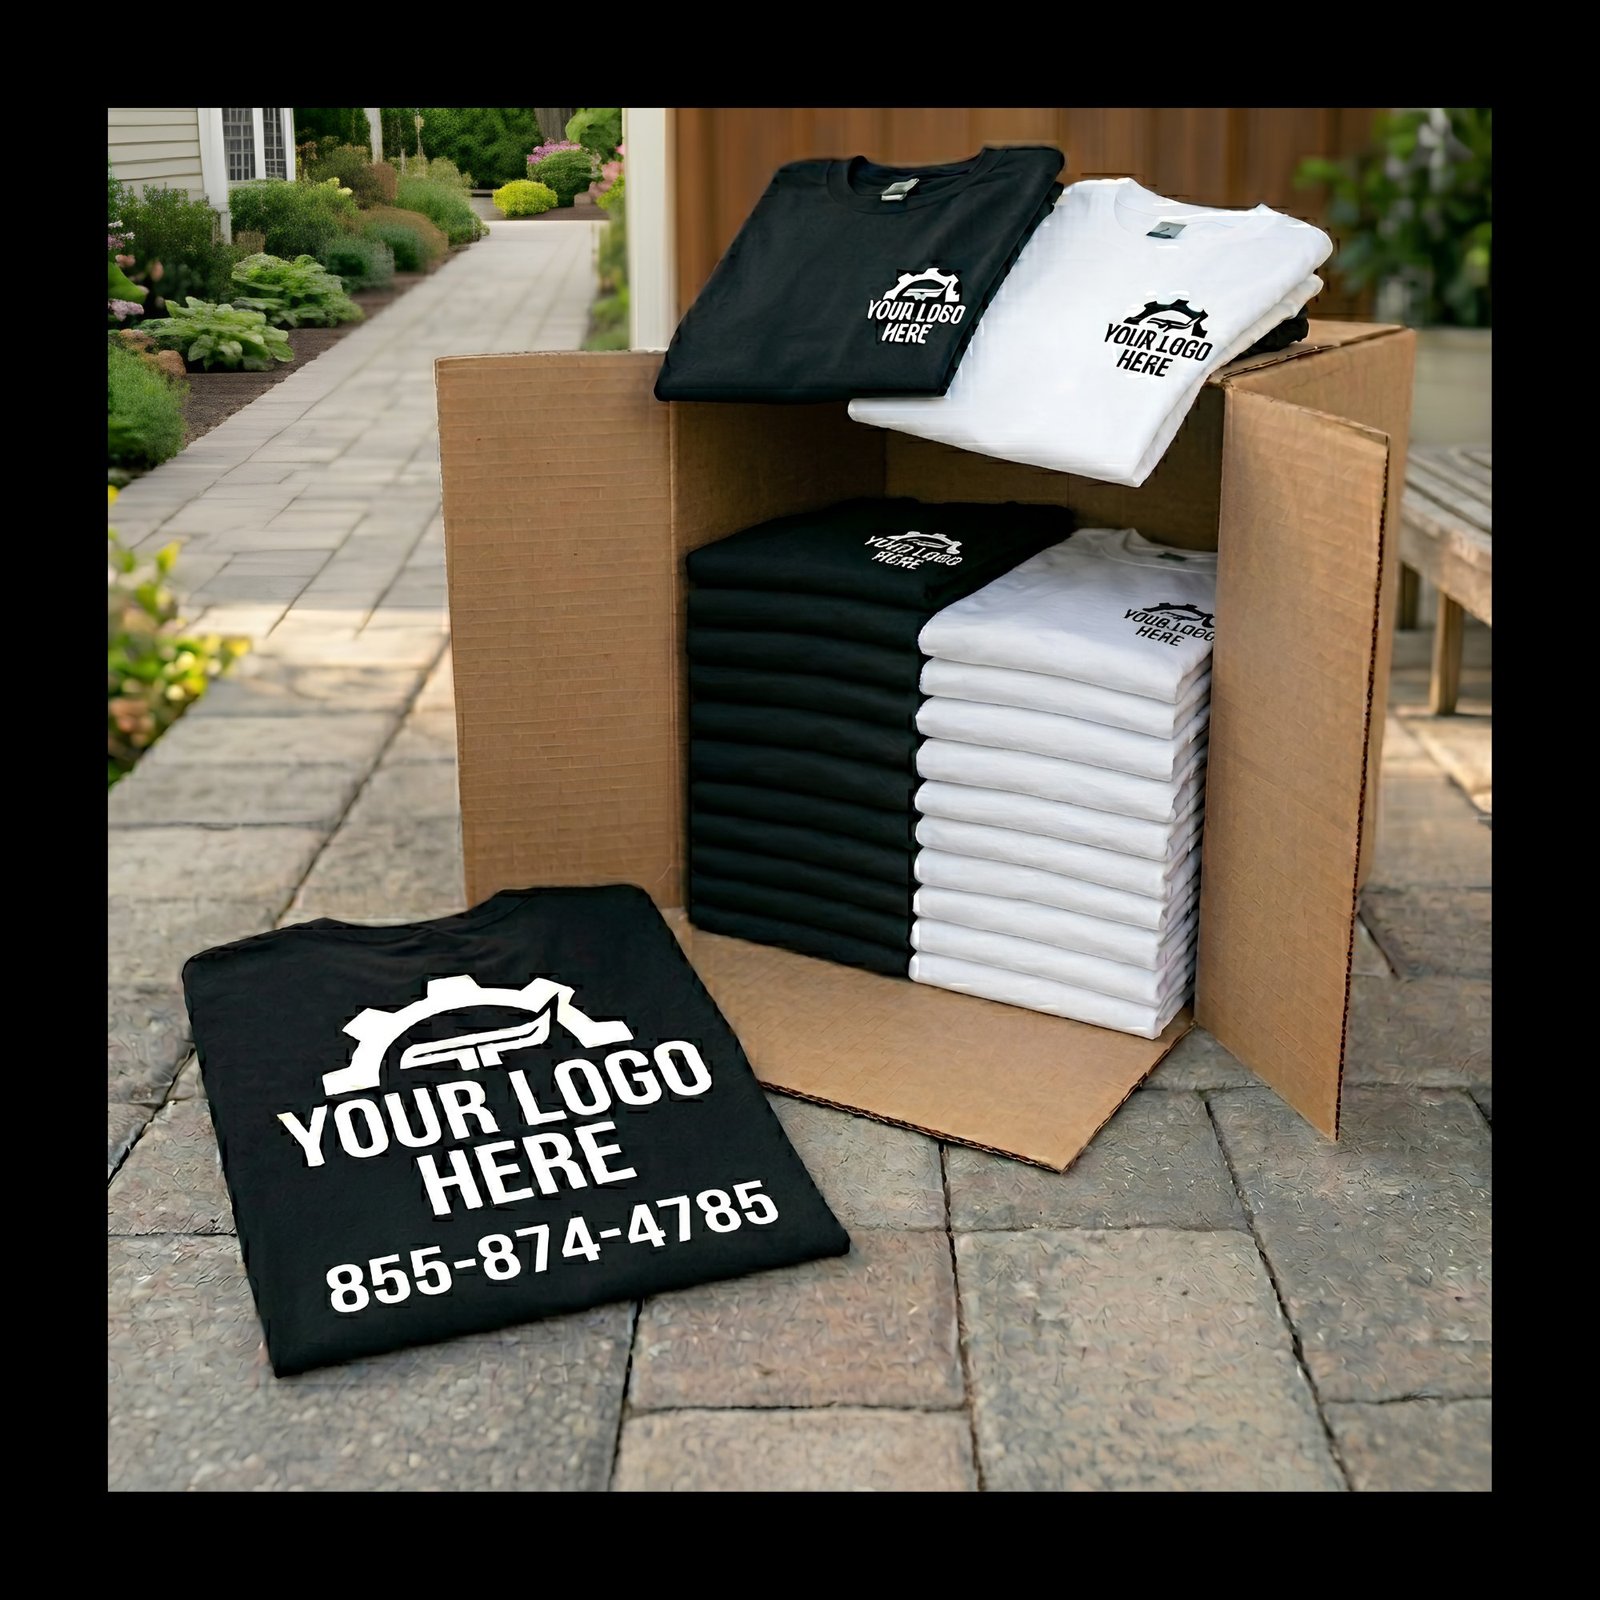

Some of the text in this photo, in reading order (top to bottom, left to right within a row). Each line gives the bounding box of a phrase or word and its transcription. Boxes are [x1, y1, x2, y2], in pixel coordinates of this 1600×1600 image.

[867, 299, 967, 325] YOUR LOGO
[881, 322, 934, 345] HERE
[1104, 323, 1214, 362] YOUR LOGO
[1116, 348, 1174, 378] HERE
[1135, 625, 1185, 647] HERE
[276, 1040, 713, 1168] YOUR LOGO
[416, 1121, 638, 1217] HERE
[325, 1180, 780, 1314] 855-874-4785
